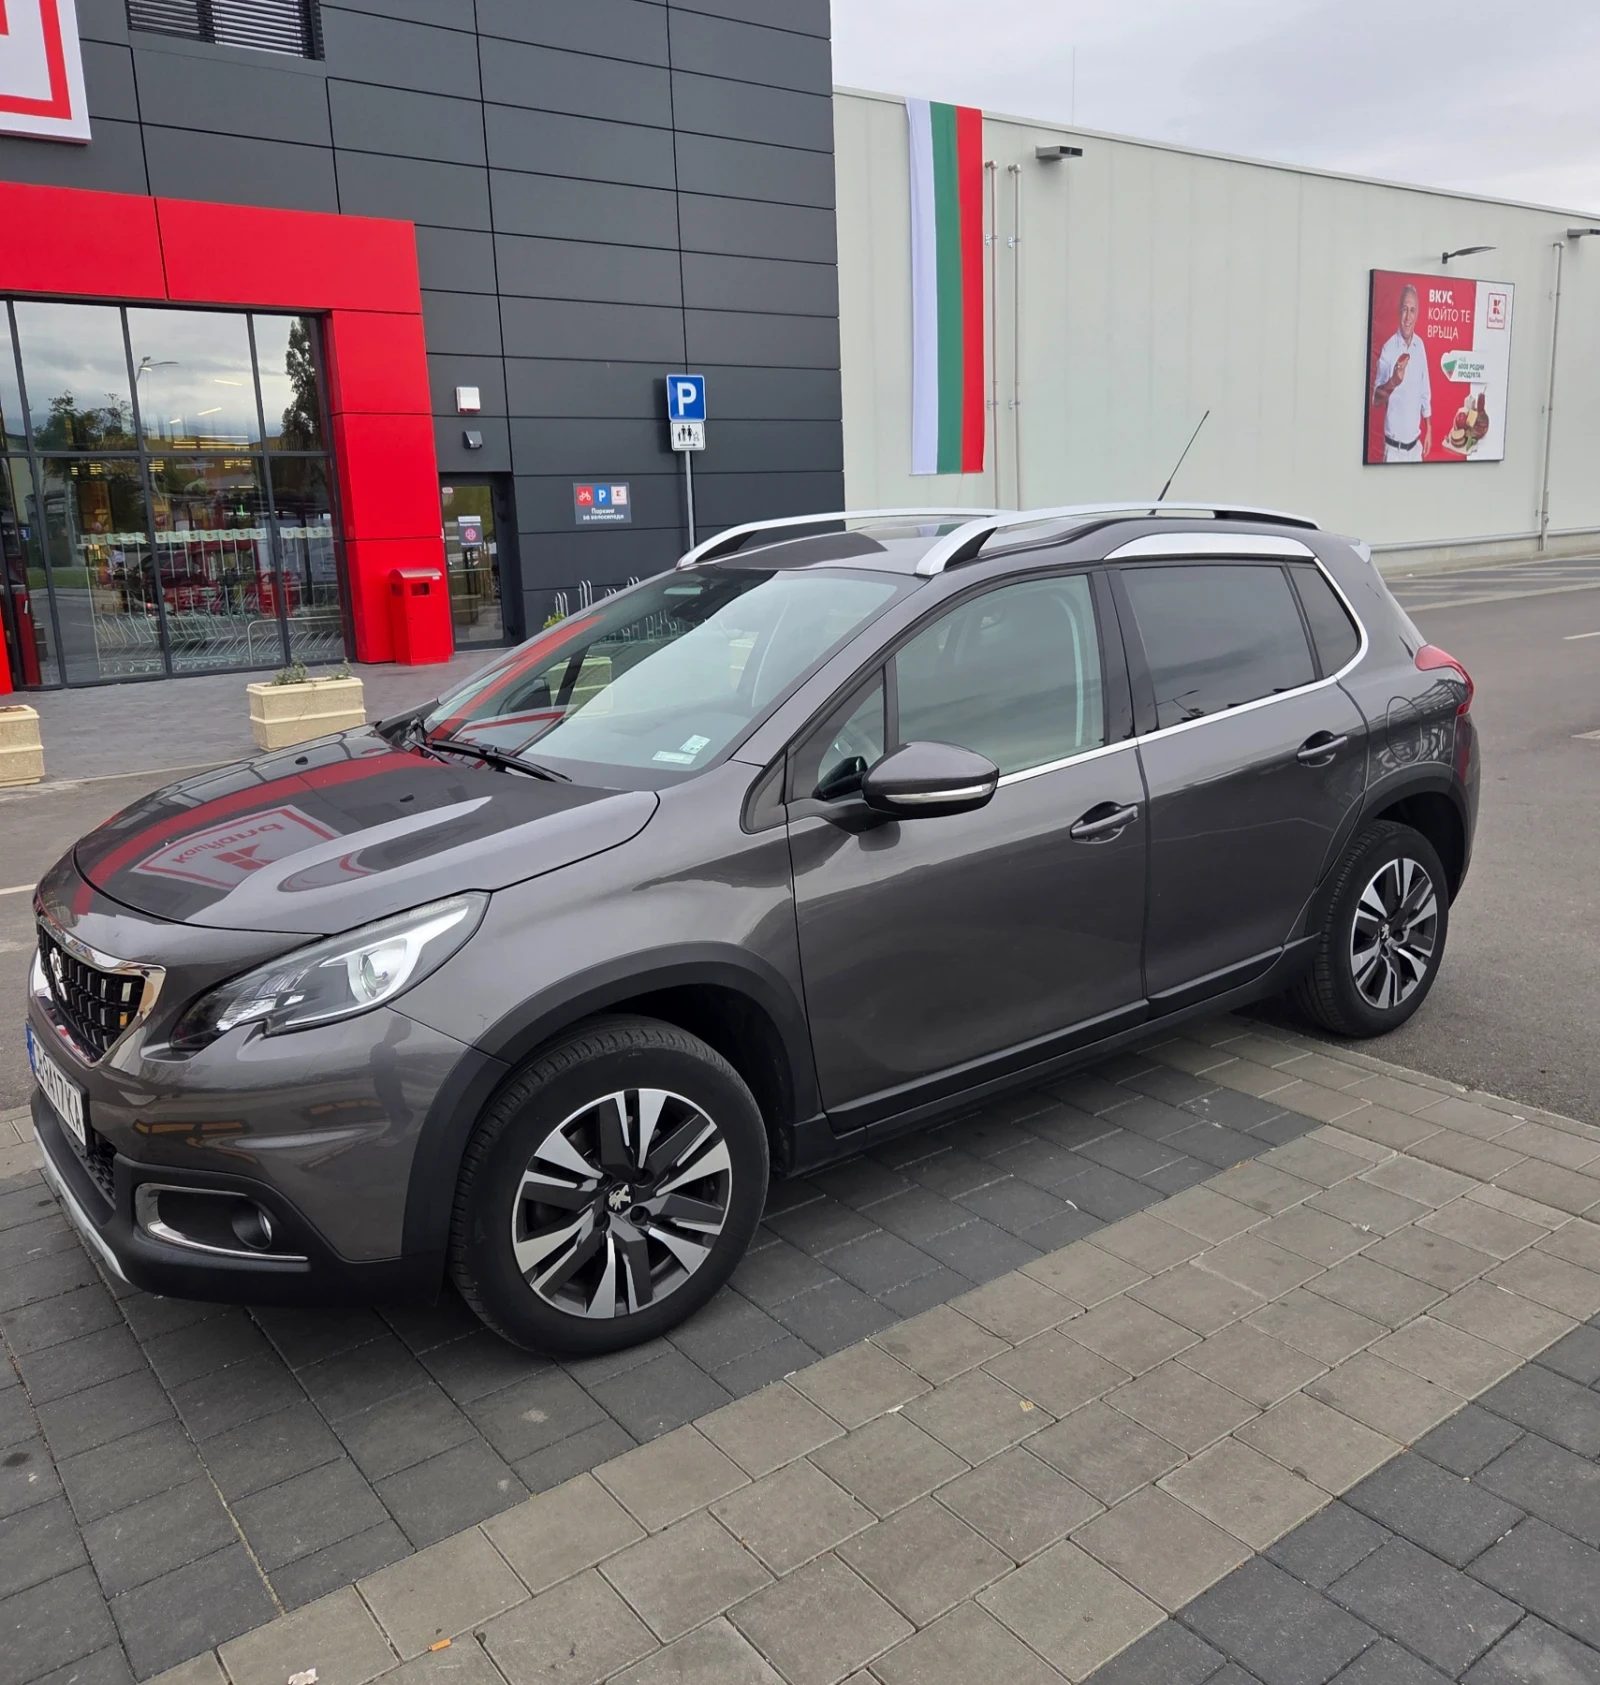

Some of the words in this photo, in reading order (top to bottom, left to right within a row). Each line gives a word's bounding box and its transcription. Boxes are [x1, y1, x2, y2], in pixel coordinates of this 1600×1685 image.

[1429, 289, 1454, 306] ВКУС,
[1428, 307, 1458, 322] КОЙТО
[1461, 310, 1470, 323] ТЕ
[1427, 325, 1459, 341] ВРЪЩА
[677, 382, 697, 415] P
[598, 489, 607, 502] P
